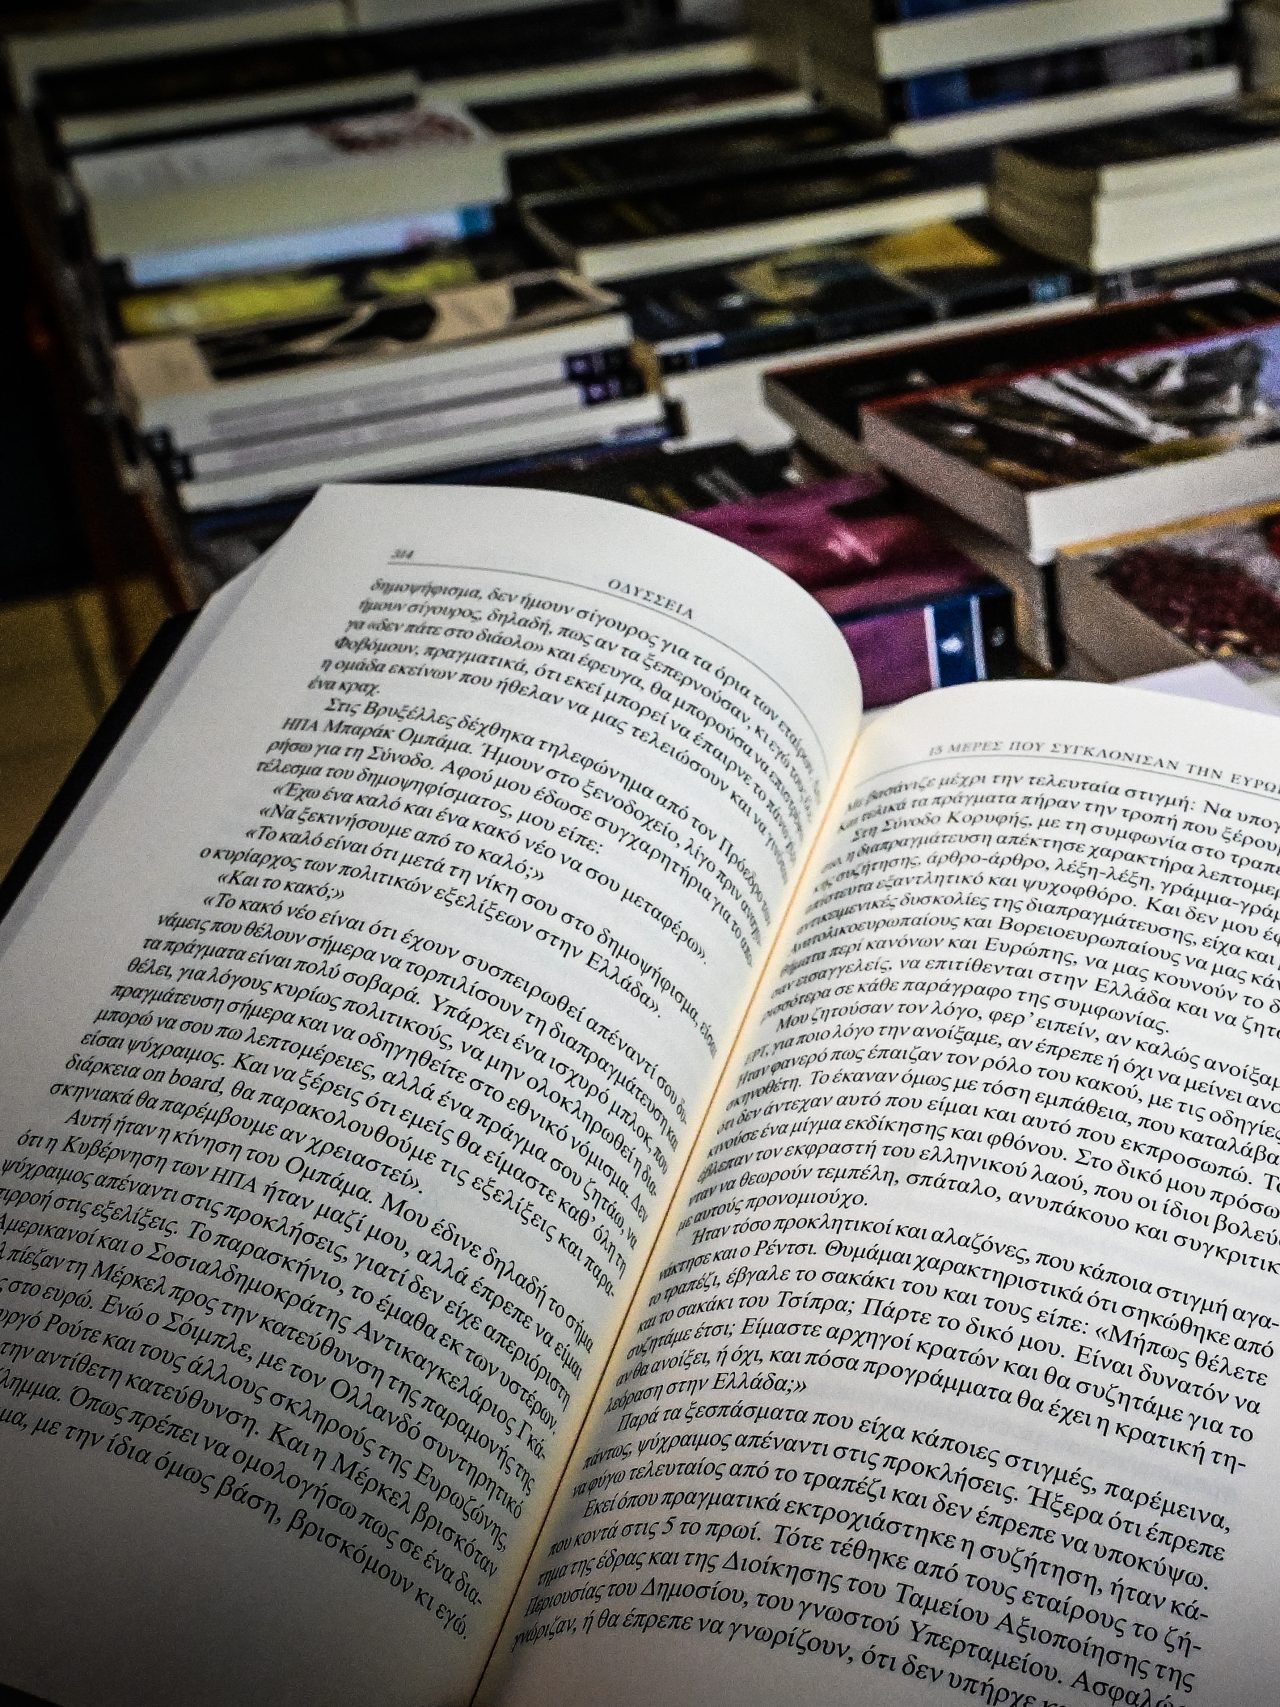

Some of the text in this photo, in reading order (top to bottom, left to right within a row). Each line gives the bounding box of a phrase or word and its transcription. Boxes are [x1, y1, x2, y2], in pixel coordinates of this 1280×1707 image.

[607, 578, 693, 620] ΟΔΥΣΣΕΙΑ
[487, 587, 752, 699] δεν ήμουν σίγουρος για τα όρια
[457, 714, 536, 747] δέχθηκα
[538, 739, 655, 800] τηλεφώνημα
[655, 794, 689, 821] από
[691, 816, 718, 841] τον
[992, 774, 1024, 788] την
[1028, 773, 1121, 796] τελευταία
[1124, 788, 1196, 813] στιγμή:
[1203, 799, 1232, 819] Να
[259, 803, 545, 881] «Να ξεκινήσουμε από το καλό;»
[272, 781, 707, 965] «Έχω ένα καλό και ένα κακό νέο να σου μεταφέρω».
[946, 810, 1033, 829] Κορυφής,
[1036, 817, 1061, 831] με
[1065, 820, 1087, 836] τη
[1090, 824, 1188, 852] συμφωνία
[1191, 844, 1226, 860] στο
[217, 869, 345, 902] «Και το κακό;»
[65, 1052, 226, 1098] διάρκεια on board,
[897, 1003, 929, 1014] τον
[930, 999, 983, 1021] λόγο,
[1035, 1017, 1100, 1043] ειπείν,
[1105, 1032, 1132, 1047] αν
[1135, 1039, 1201, 1070] καλώς
[49, 1083, 423, 1195] σκηνιακά θα παρέμβουμε αν χρειαστεί».
[759, 1122, 790, 1139] ένα
[788, 1116, 843, 1138] μίγμα
[844, 1114, 949, 1142] εκδίκησης
[950, 1127, 983, 1143] και
[986, 1131, 1067, 1161] φθόνου.
[1074, 1147, 1113, 1172] Στο
[1116, 1158, 1163, 1185] δικό
[1165, 1177, 1206, 1198] μου
[744, 1187, 868, 1213] προνομιούχο.
[732, 1216, 772, 1235] τόσο
[772, 1212, 895, 1235] προκλητικοί
[894, 1224, 928, 1241] και
[930, 1227, 1031, 1265] αλαζόνες,
[1035, 1252, 1075, 1272] που
[1078, 1262, 1153, 1295] κάποια
[1156, 1286, 1228, 1322] στιγμή
[1232, 1307, 1280, 1330] αγα-
[665, 1371, 807, 1397] στην Ελλάδα;»
[776, 1290, 1261, 1415] Τσίπρα; Πάρτε το δικό μου. Είναι δυνατόν να
[614, 1399, 1231, 1535] Παρά τα ξεσπάσματα που είχα κάποιες στιγμές, παρέμεινα,
[29, 1416, 468, 1640] με την ίδια όμως βάση, βρισκόμουν κι εγώ.
[572, 1515, 1202, 1659] κοντά στις 5 το πρωί. Τότε τέθηκε από τους εταίρους το ζή-
